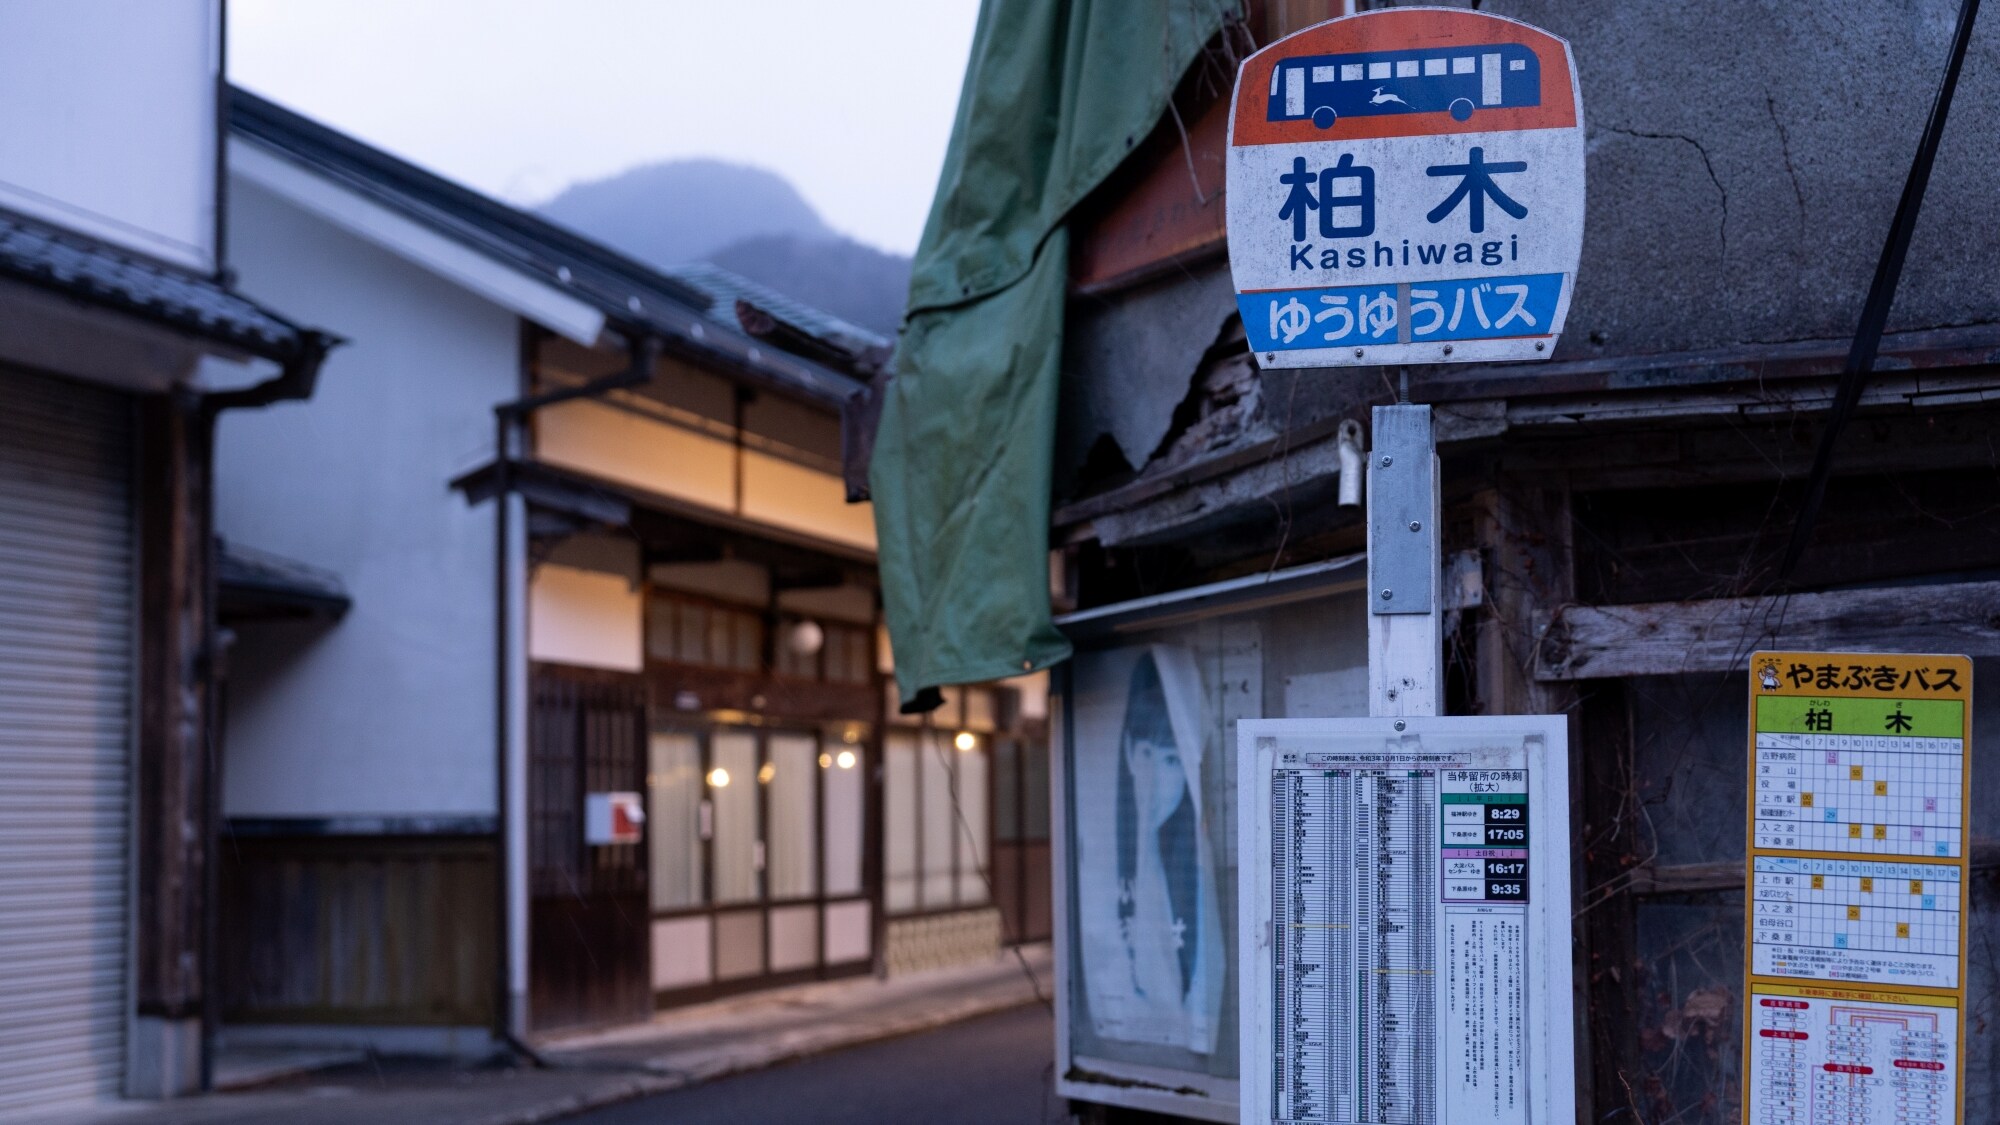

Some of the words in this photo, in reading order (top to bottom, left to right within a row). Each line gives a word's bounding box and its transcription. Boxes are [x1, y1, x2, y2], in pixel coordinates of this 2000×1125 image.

[1290, 234, 1518, 271] Kashiwagi
[1269, 283, 1536, 344] ゆうゆうバス
[1786, 663, 1962, 692] やまぶきバス
[1761, 752, 1797, 760] 吉野病院
[1447, 771, 1523, 782] 当停留所の時刻
[1761, 795, 1796, 804] 上市駅
[1491, 809, 1520, 819] 8:29
[1760, 823, 1795, 833] 入之波
[1487, 829, 1524, 840] 17:05
[1760, 837, 1795, 846] 下桑原
[1487, 863, 1524, 874] 16:17
[1875, 866, 1884, 874] 12
[1888, 866, 1896, 874] 13
[1900, 866, 1908, 874] 14
[1912, 867, 1921, 875] 15
[1925, 868, 1934, 876] 16
[1937, 868, 1946, 876] 17
[1950, 869, 1958, 877] 18
[1759, 875, 1794, 885] 上市駅
[1491, 884, 1520, 895] 9:35
[1759, 904, 1794, 914] 入之波
[1759, 918, 1793, 928] 伯母谷口
[1759, 932, 1793, 942] 下桑原
